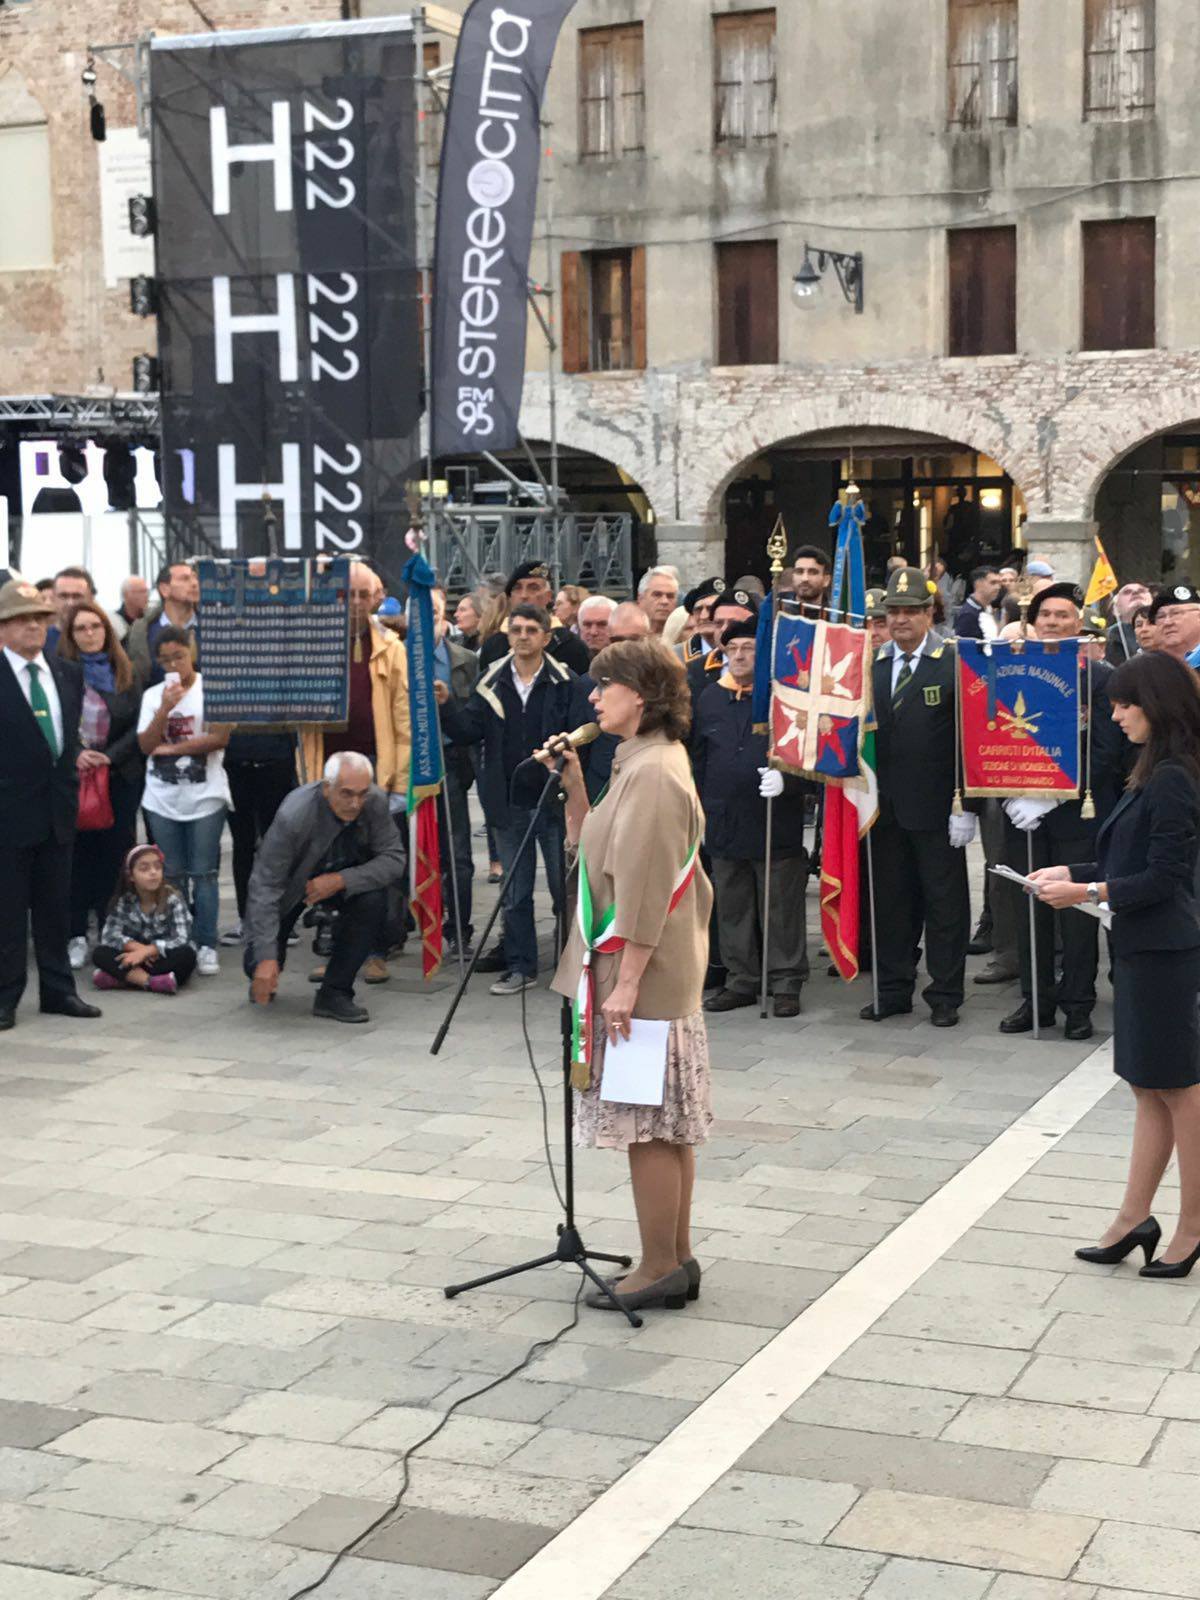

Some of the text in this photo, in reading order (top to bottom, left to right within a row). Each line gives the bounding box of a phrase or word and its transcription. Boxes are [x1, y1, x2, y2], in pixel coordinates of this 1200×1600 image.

[210, 101, 293, 216] H
[304, 98, 356, 211] 222
[213, 273, 298, 384] H
[307, 272, 360, 382] 222
[456, 400, 495, 436] 95
[458, 386, 495, 402] FM
[217, 443, 302, 550] H
[313, 443, 364, 551] 222
[1027, 665, 1075, 698] NAZIONALE
[1022, 745, 1062, 757] D'ITALIA
